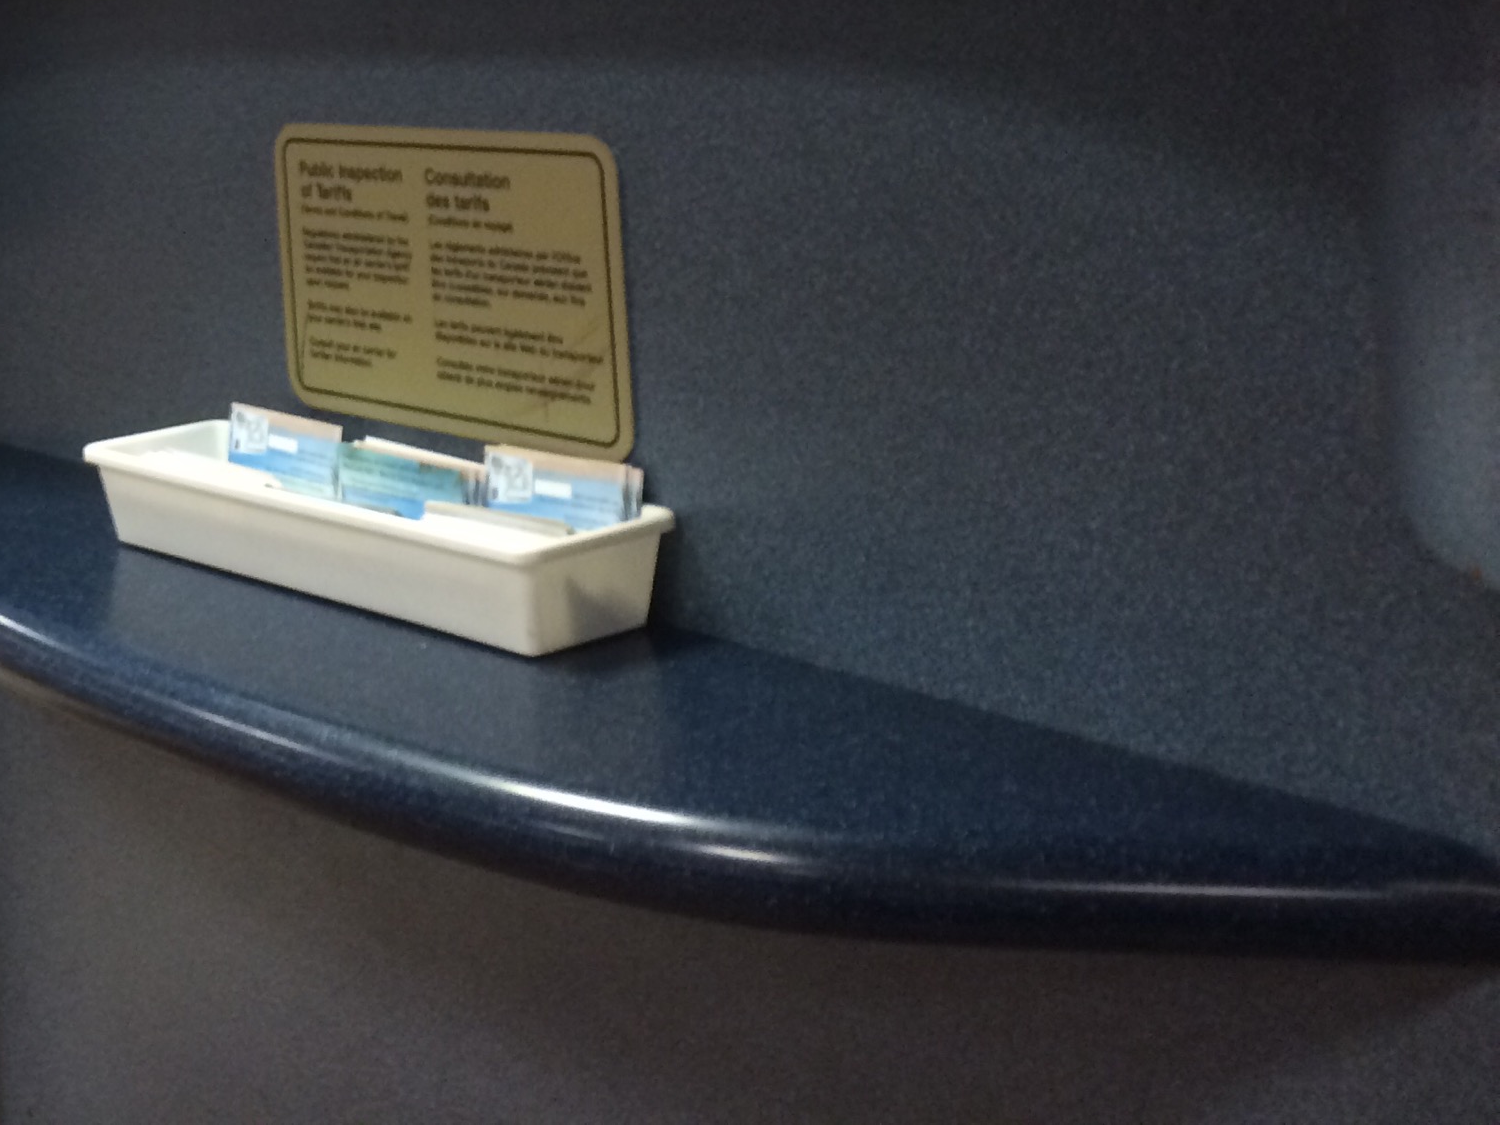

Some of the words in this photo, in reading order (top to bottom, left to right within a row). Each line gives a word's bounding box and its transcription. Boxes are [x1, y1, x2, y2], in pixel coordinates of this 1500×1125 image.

[300, 159, 334, 178] Public
[425, 167, 511, 190] Consultation
[301, 184, 312, 198] of
[426, 192, 449, 210] des
[454, 194, 491, 212] tarifs
